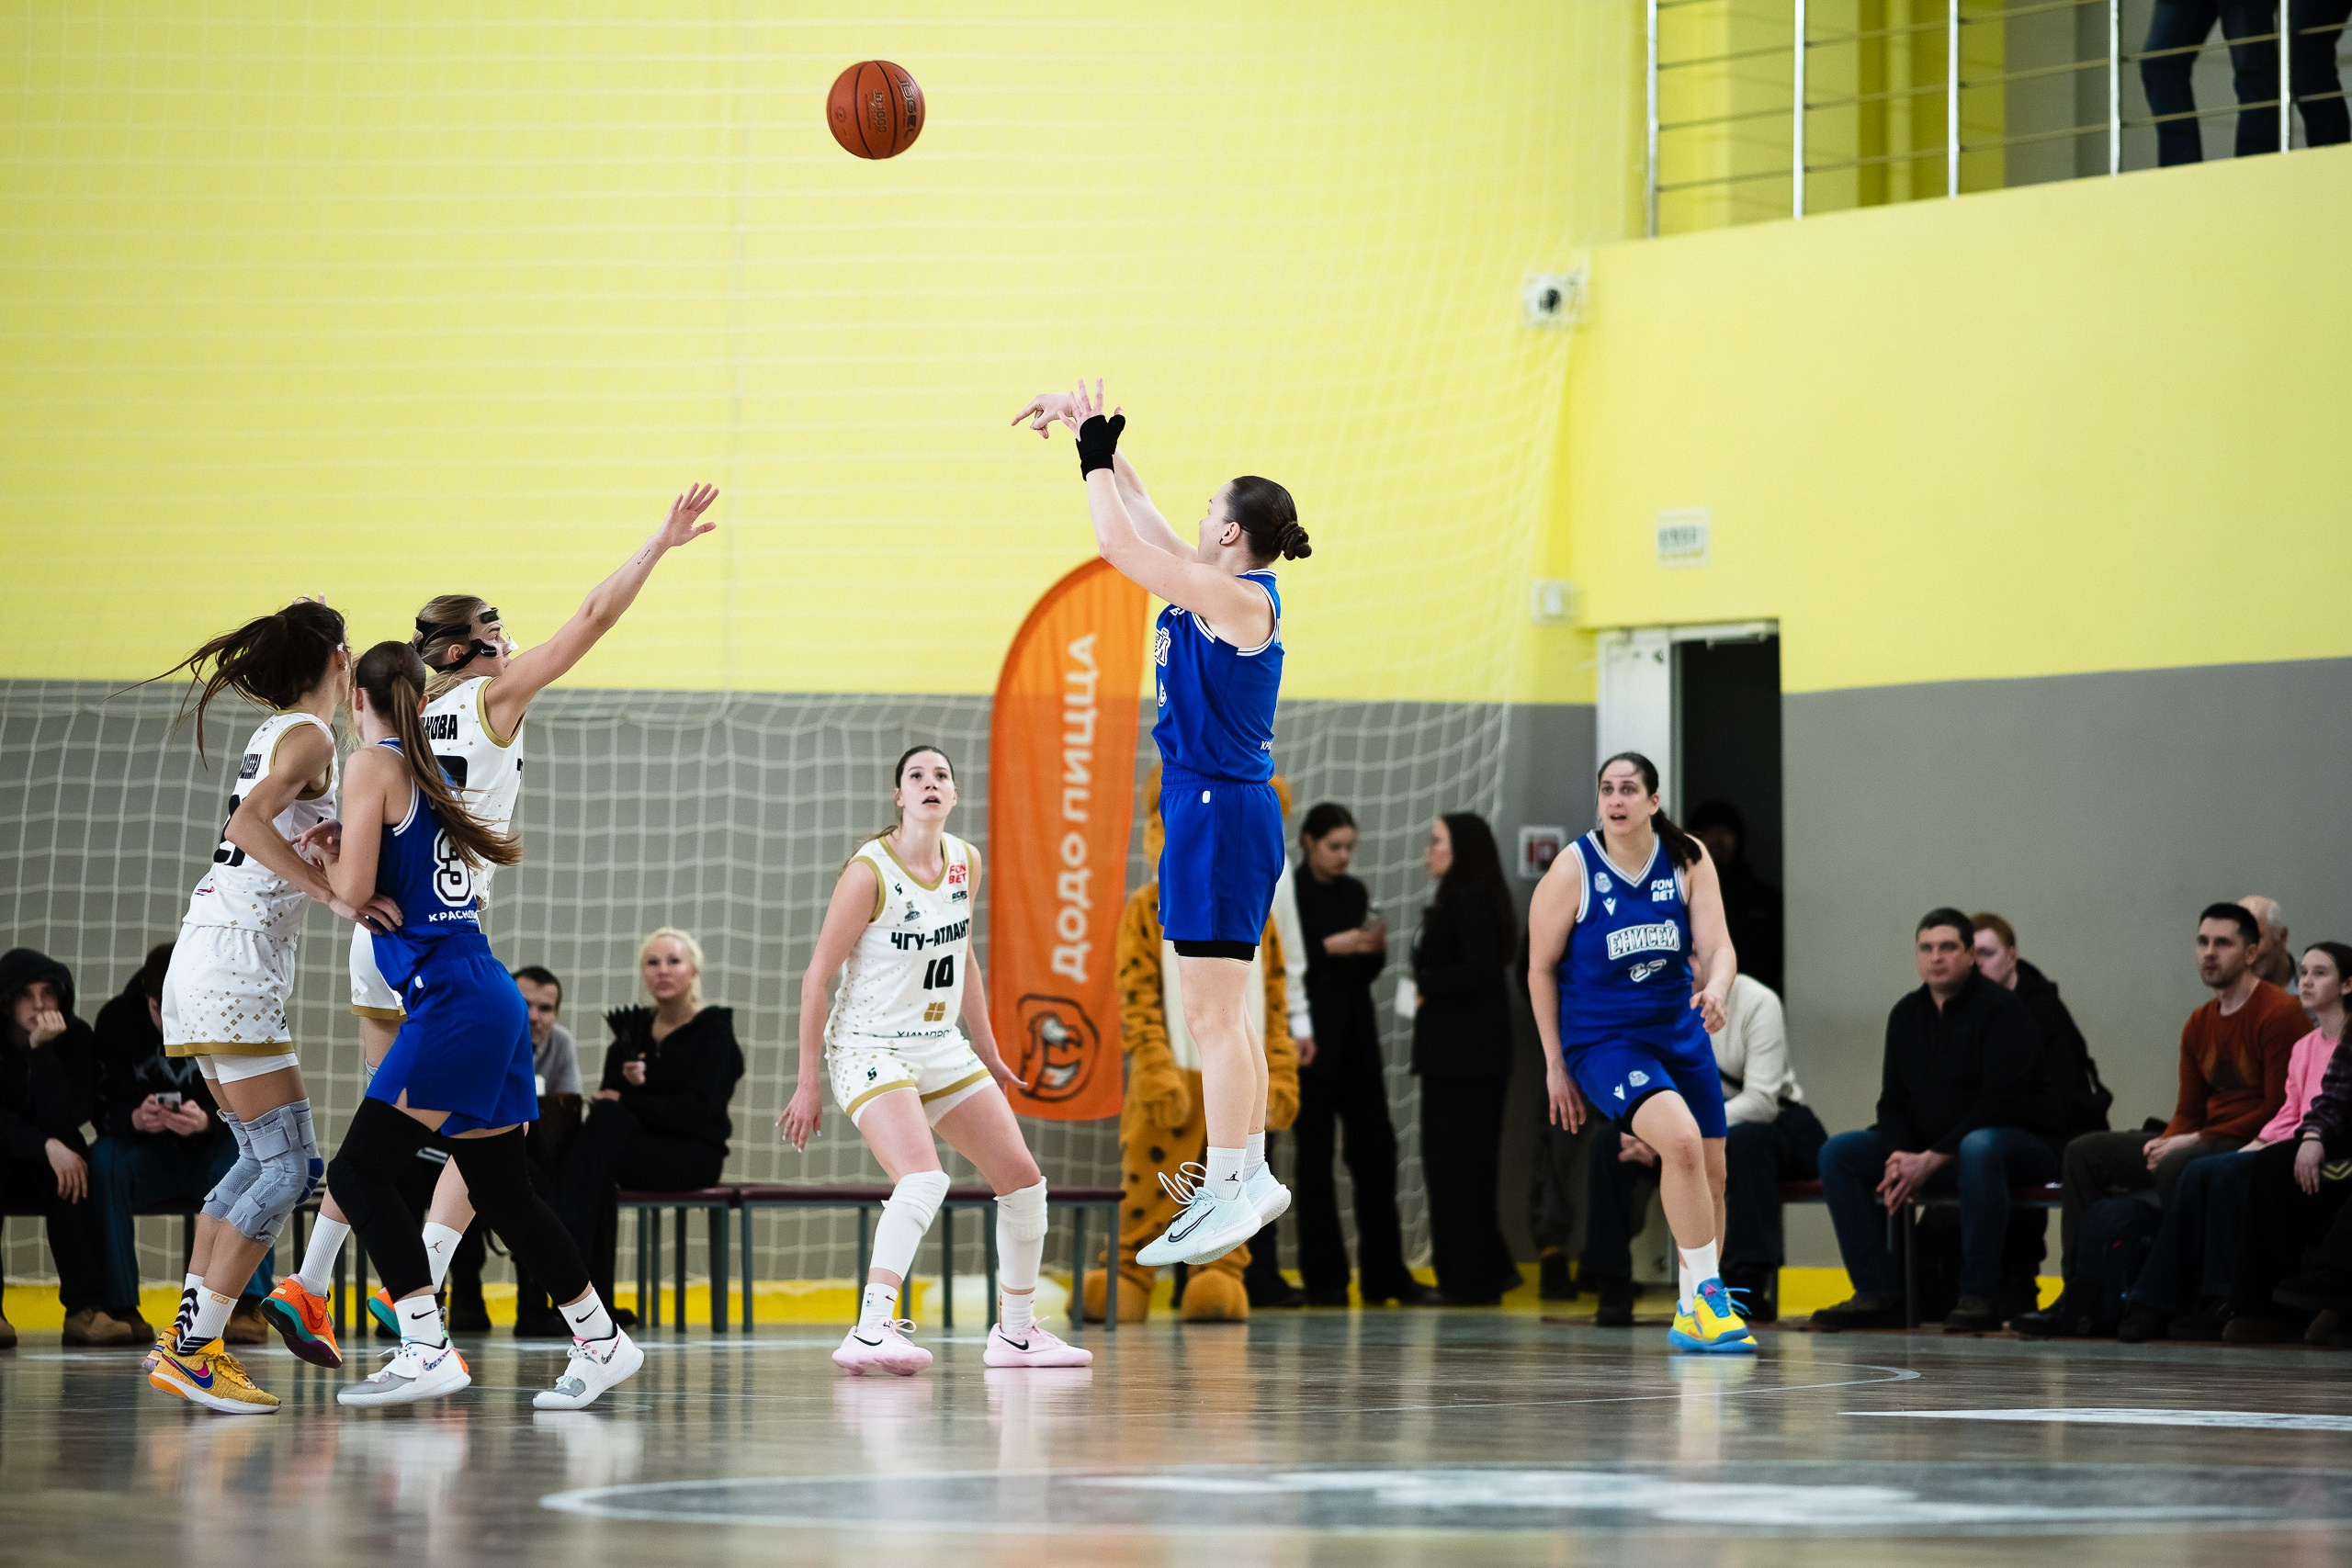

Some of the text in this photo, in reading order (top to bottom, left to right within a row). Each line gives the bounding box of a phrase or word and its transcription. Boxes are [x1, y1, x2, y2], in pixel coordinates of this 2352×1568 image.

[1051, 633, 1100, 983] ДОДО ПИЦЦА
[949, 863, 967, 874] FON
[948, 873, 967, 885] BET
[1650, 878, 1674, 892] FON
[1651, 888, 1676, 902] BET
[1607, 919, 1680, 960] ЕНИСЕЙ
[922, 953, 954, 990] 10
